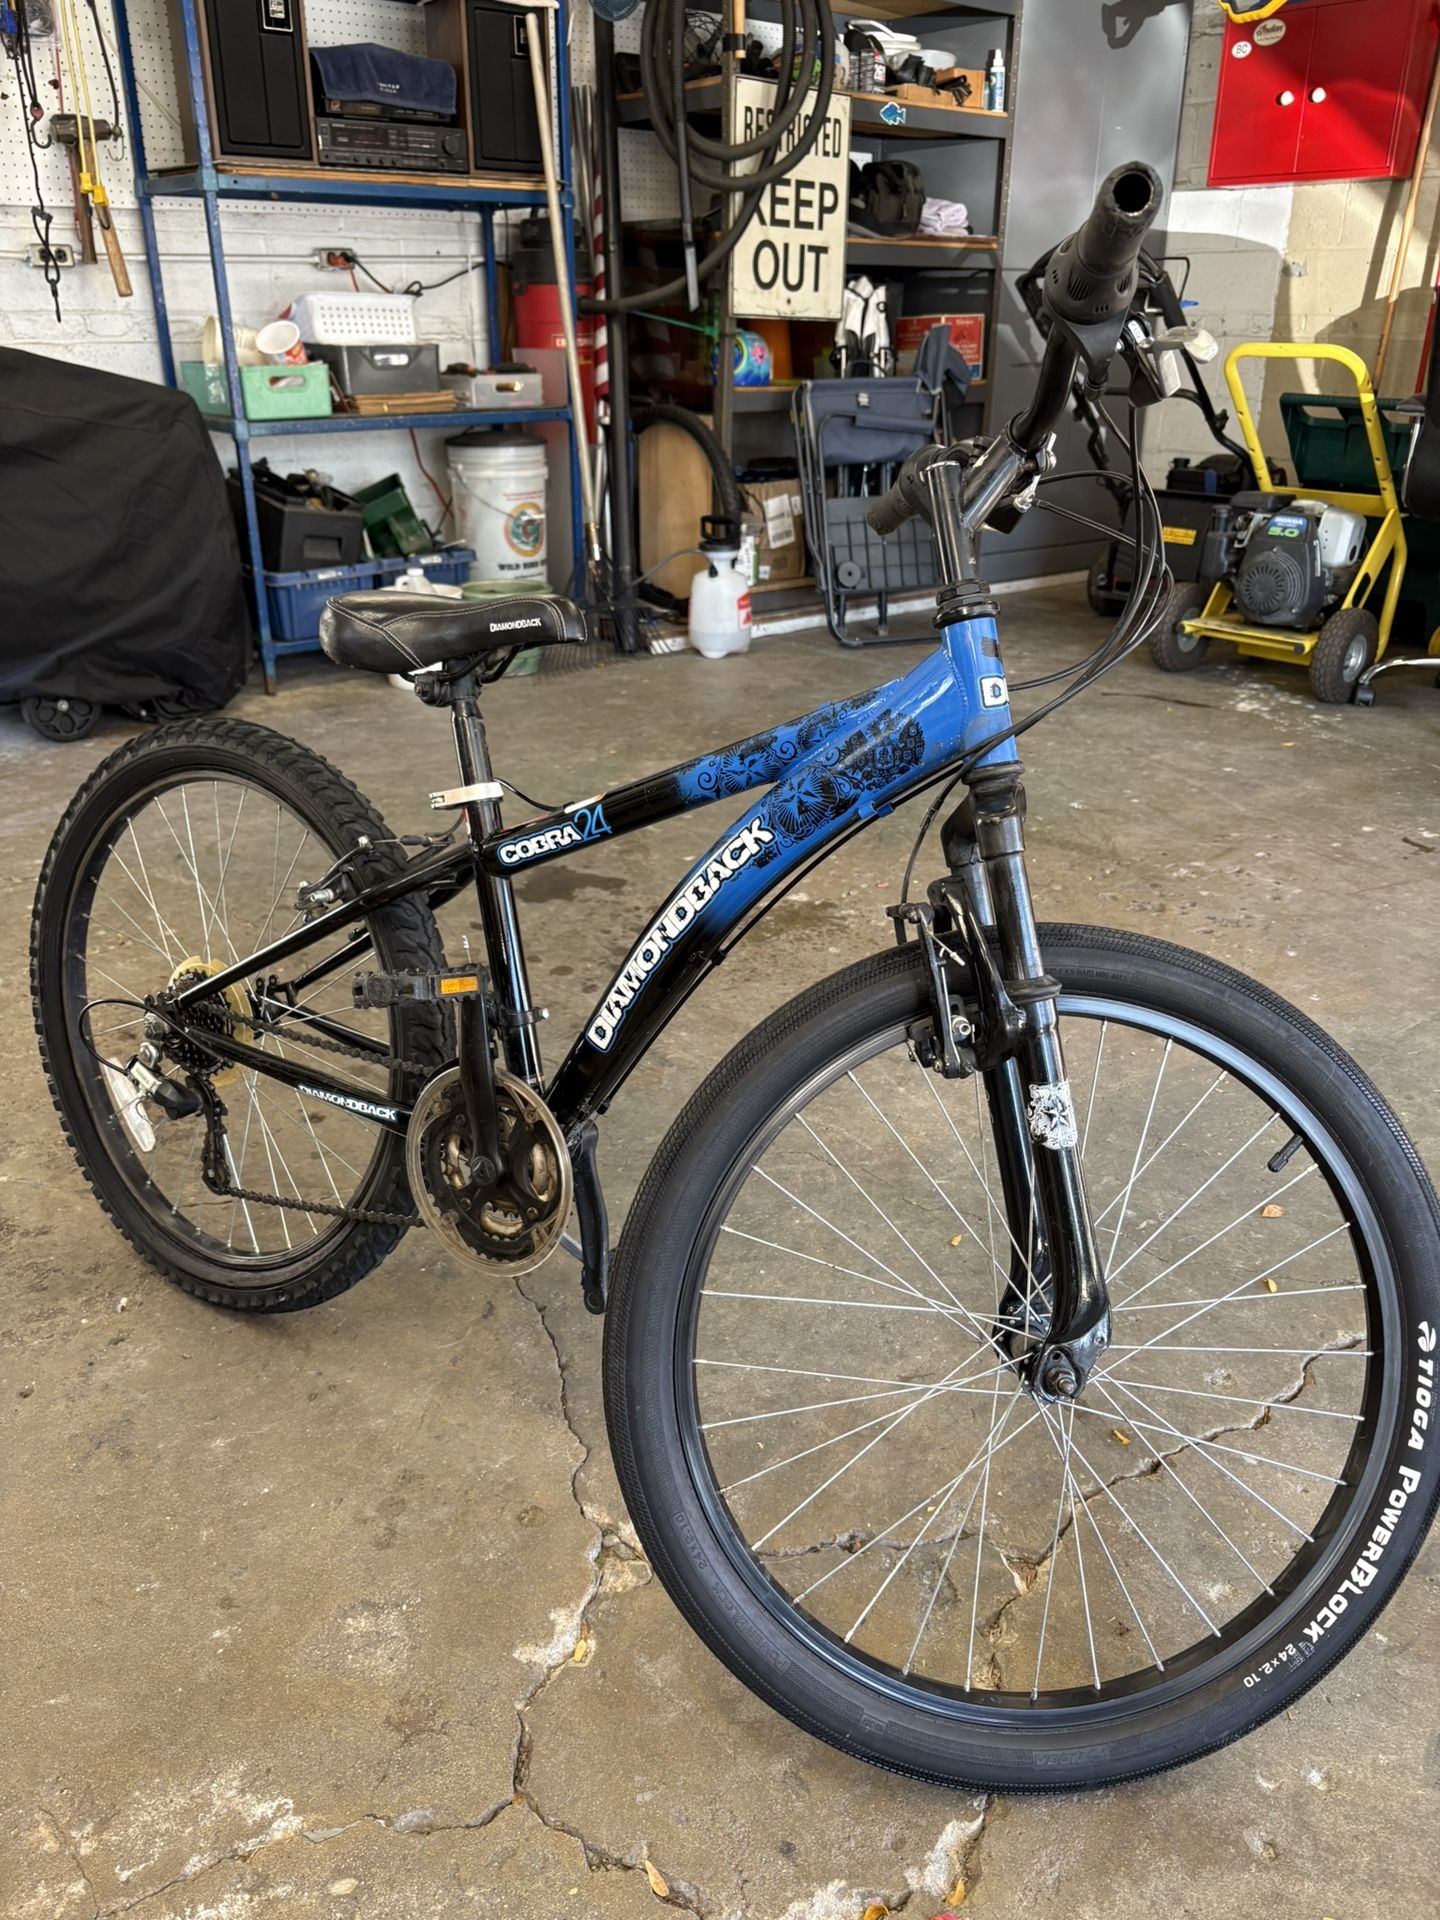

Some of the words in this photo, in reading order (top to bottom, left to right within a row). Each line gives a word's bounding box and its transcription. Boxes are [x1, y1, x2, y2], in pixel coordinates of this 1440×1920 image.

[744, 105, 841, 158] RERIED
[752, 238, 829, 293] OUT
[489, 617, 542, 633] DIAMONDBACK
[498, 823, 584, 864] COBRA
[574, 803, 613, 840] 24
[585, 816, 776, 1052] DIAMONDBACK
[298, 1084, 397, 1121] DIAMONDBACK
[1407, 1359, 1434, 1451] TIOGA
